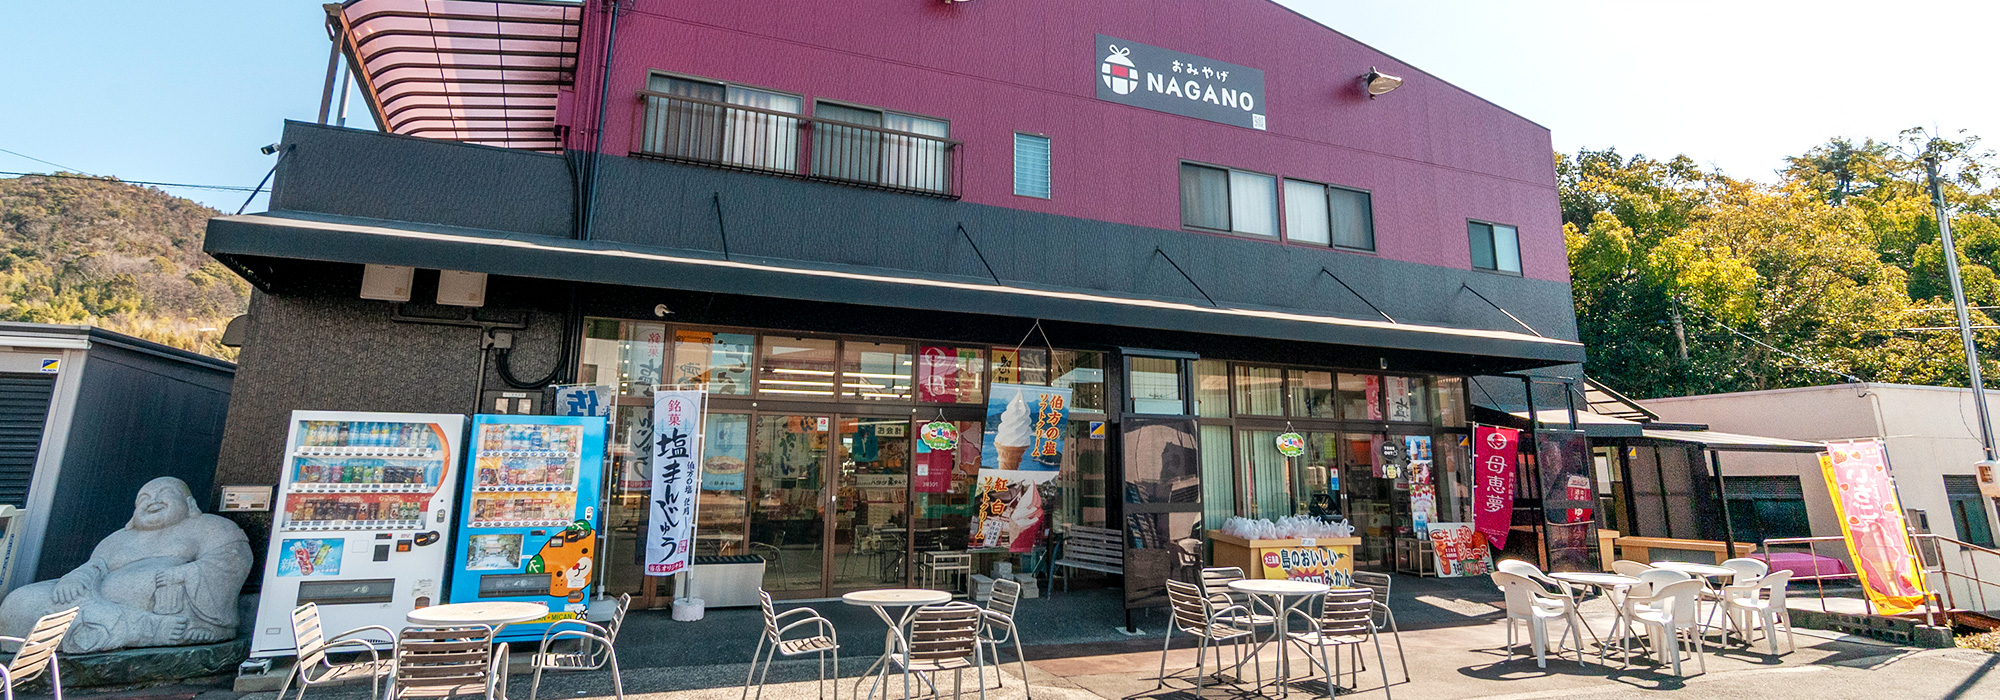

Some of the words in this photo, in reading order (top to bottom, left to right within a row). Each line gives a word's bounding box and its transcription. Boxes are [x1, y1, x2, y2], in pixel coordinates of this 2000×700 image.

[1147, 72, 1254, 111] NAGANO
[1172, 60, 1229, 83] おみやげ
[667, 399, 682, 427] 銘菓
[1031, 394, 1049, 457] ソフトクリーム
[1042, 395, 1064, 456] 伯方の塩
[656, 427, 690, 564] 塩まんじゅう
[974, 476, 993, 540] ソフトクリーム
[1484, 455, 1508, 513] 母恵夢
[1281, 549, 1337, 569] 島のおいしい
[1325, 569, 1351, 587] みかん
